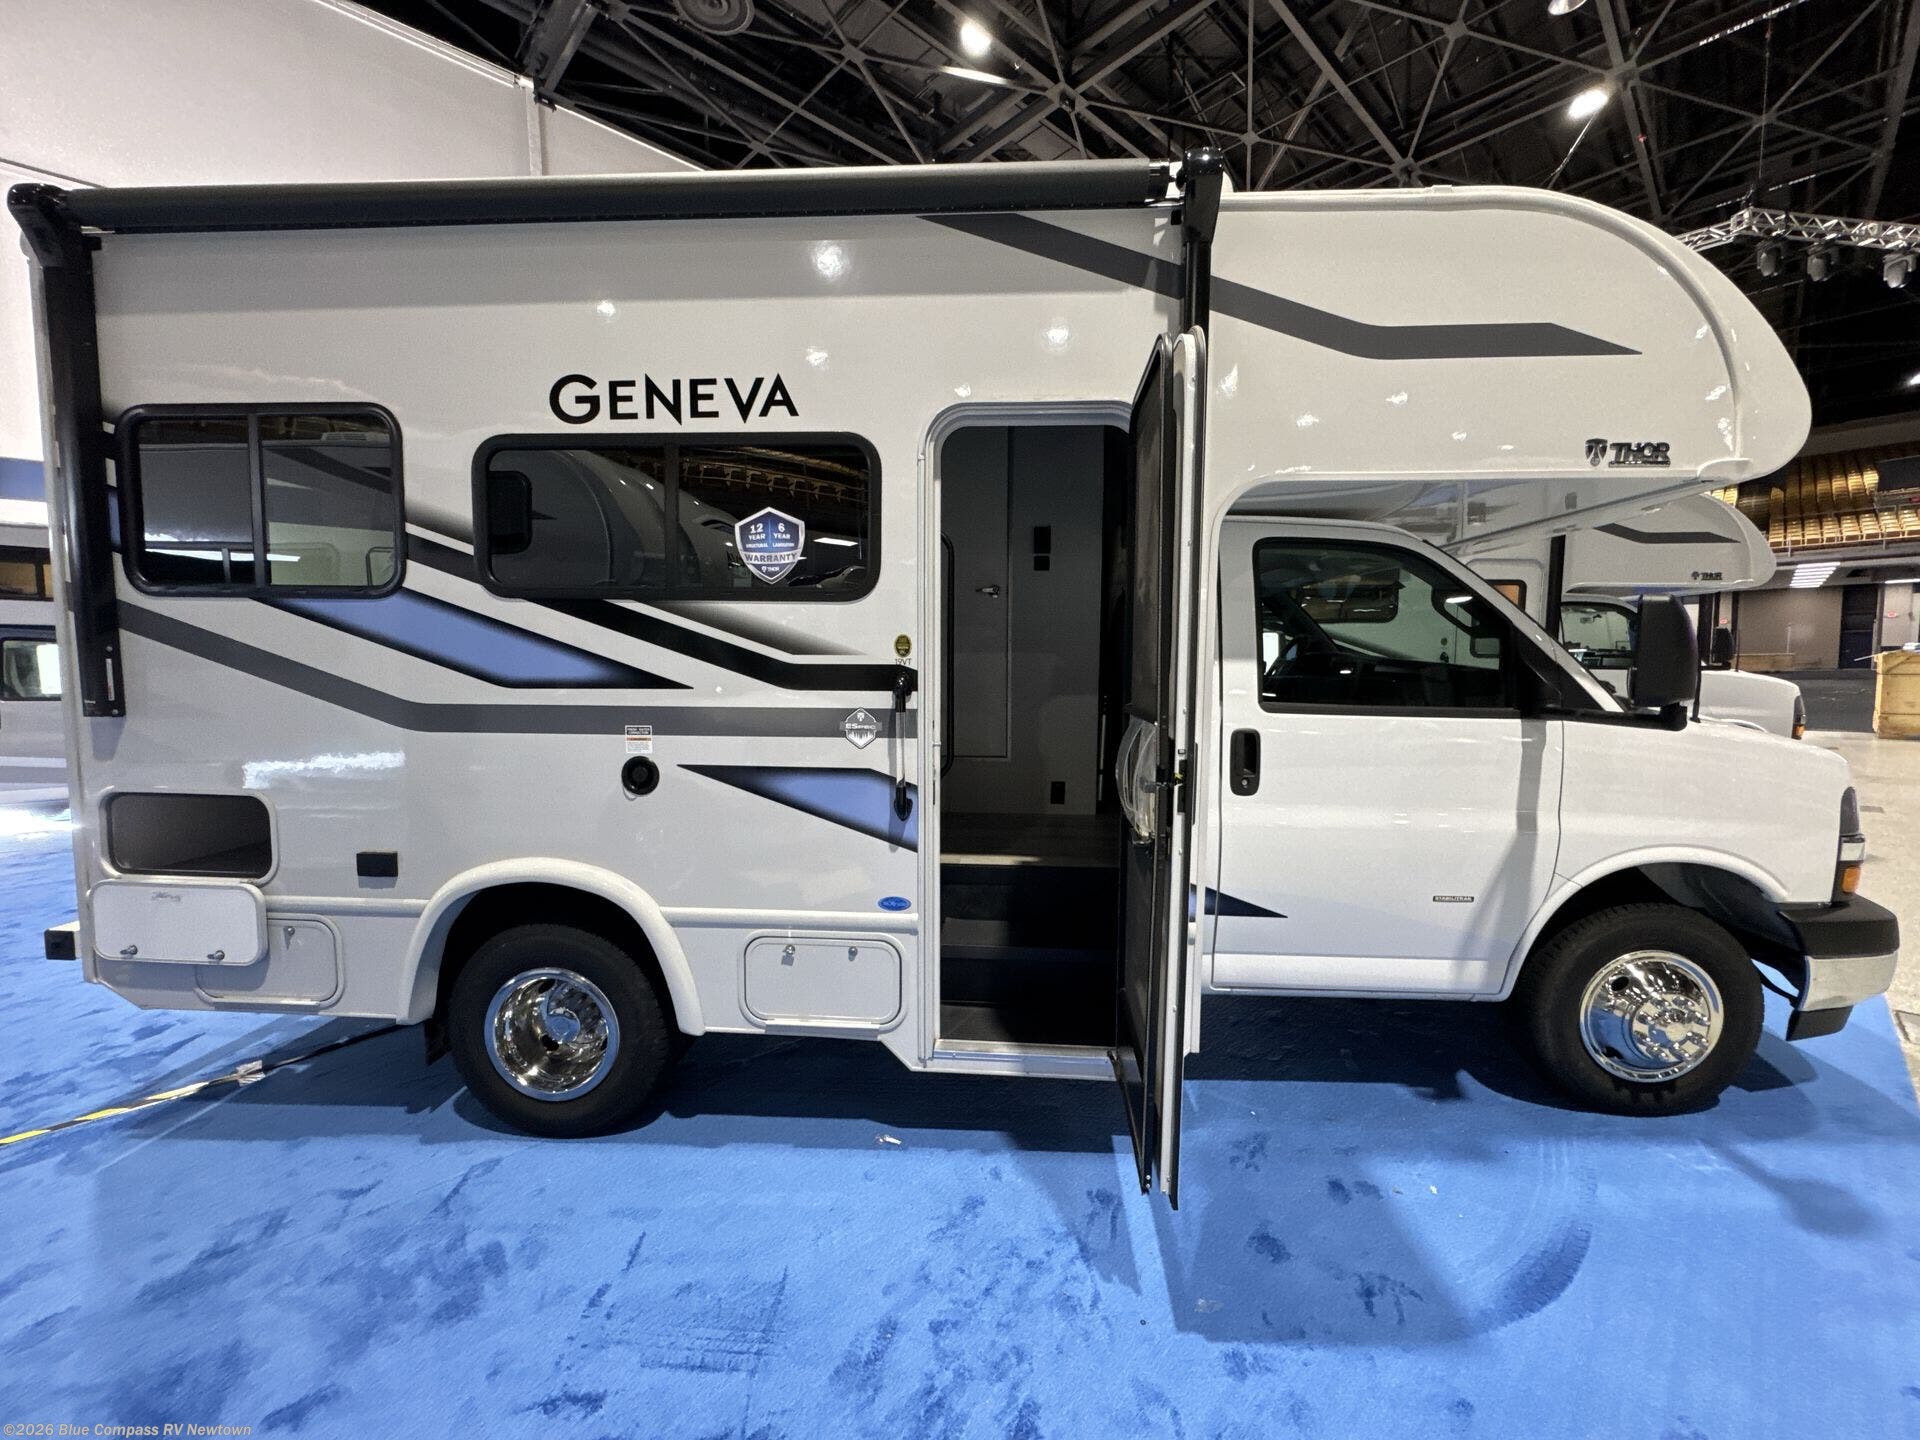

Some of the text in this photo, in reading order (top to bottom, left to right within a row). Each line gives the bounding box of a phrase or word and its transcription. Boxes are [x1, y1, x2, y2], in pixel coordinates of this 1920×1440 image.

[1699, 2, 1791, 46] MAX LOAD LIMIT
[549, 373, 800, 426] GENEVA
[1610, 442, 1670, 461] THOR
[750, 522, 764, 534] 12
[778, 522, 786, 533] 6
[748, 533, 766, 541] YEAR
[773, 532, 791, 540] YEAR
[745, 552, 798, 563] WARRANTY
